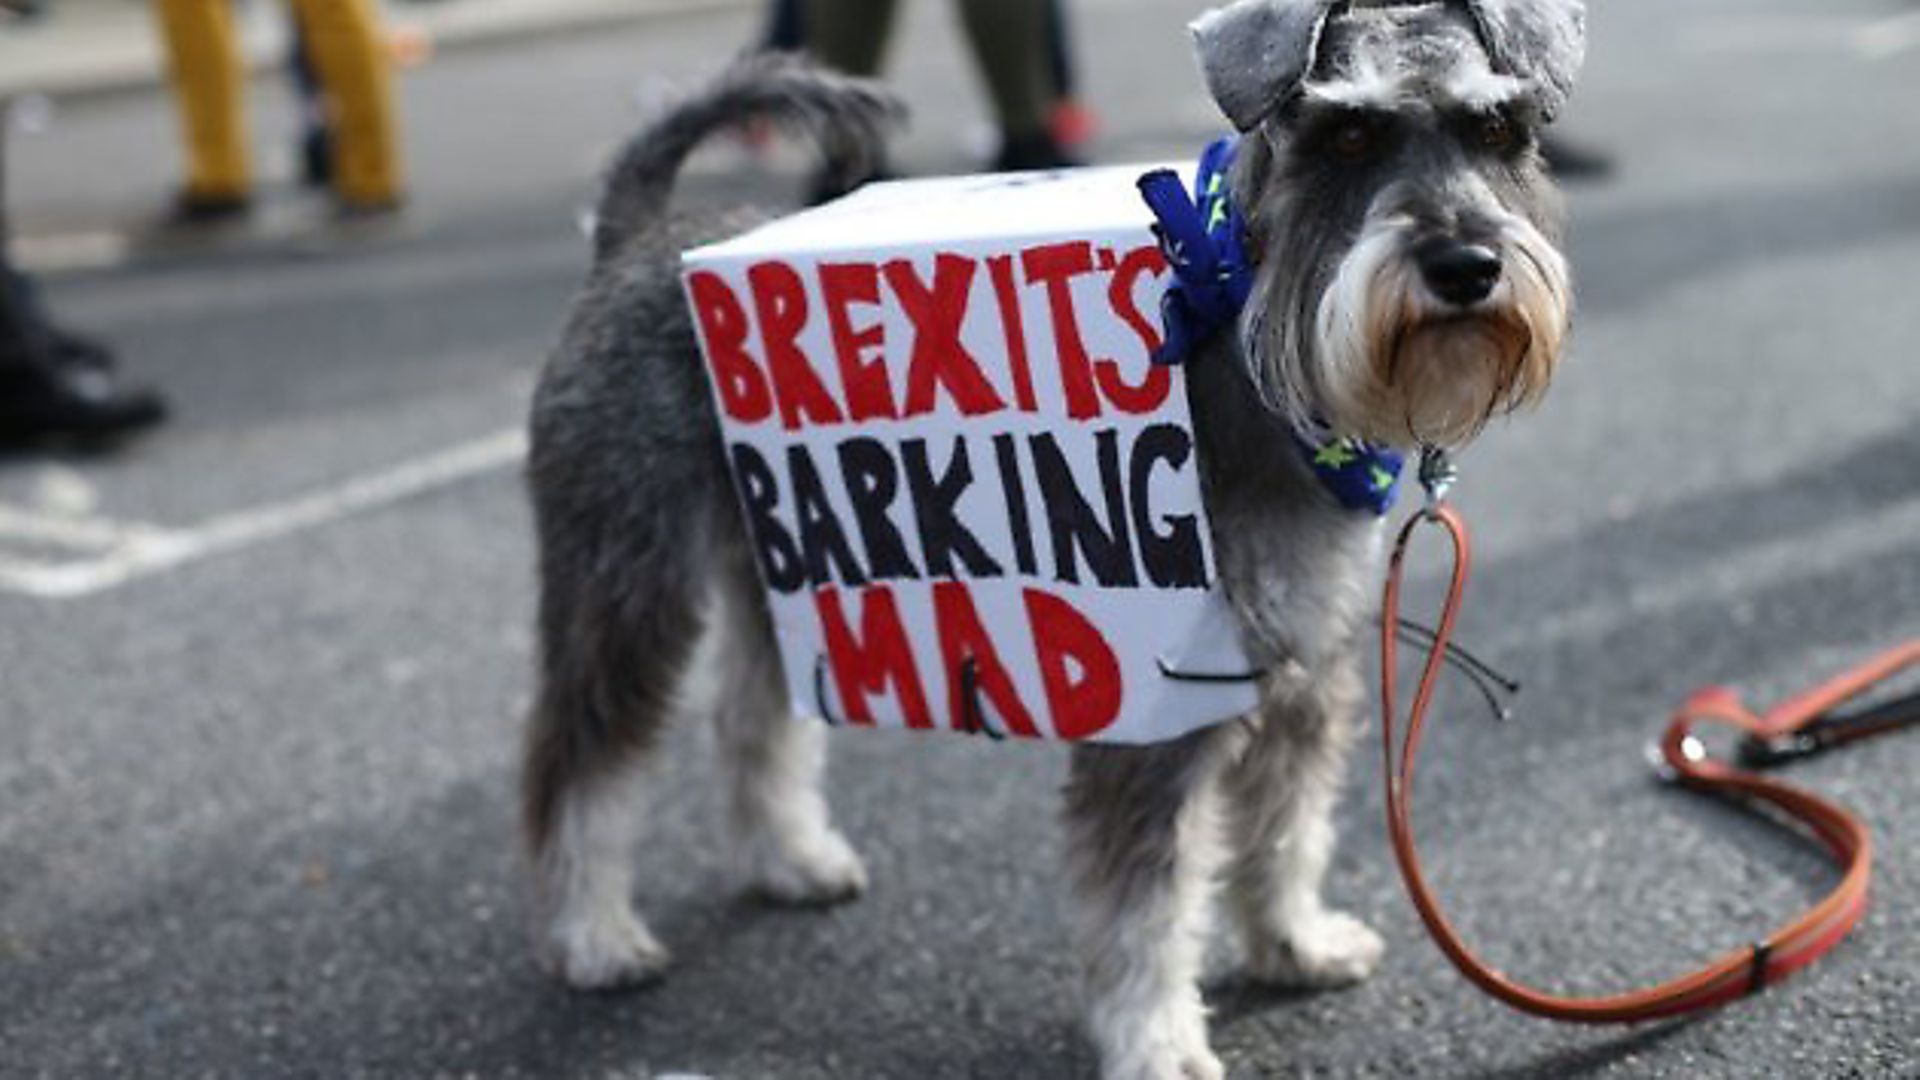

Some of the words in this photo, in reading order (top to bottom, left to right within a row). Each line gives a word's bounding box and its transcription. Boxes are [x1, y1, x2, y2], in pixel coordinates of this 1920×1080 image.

[687, 240, 1172, 431] BREXIT'S
[732, 423, 1211, 593] BARKING
[814, 581, 1123, 740] MAD
